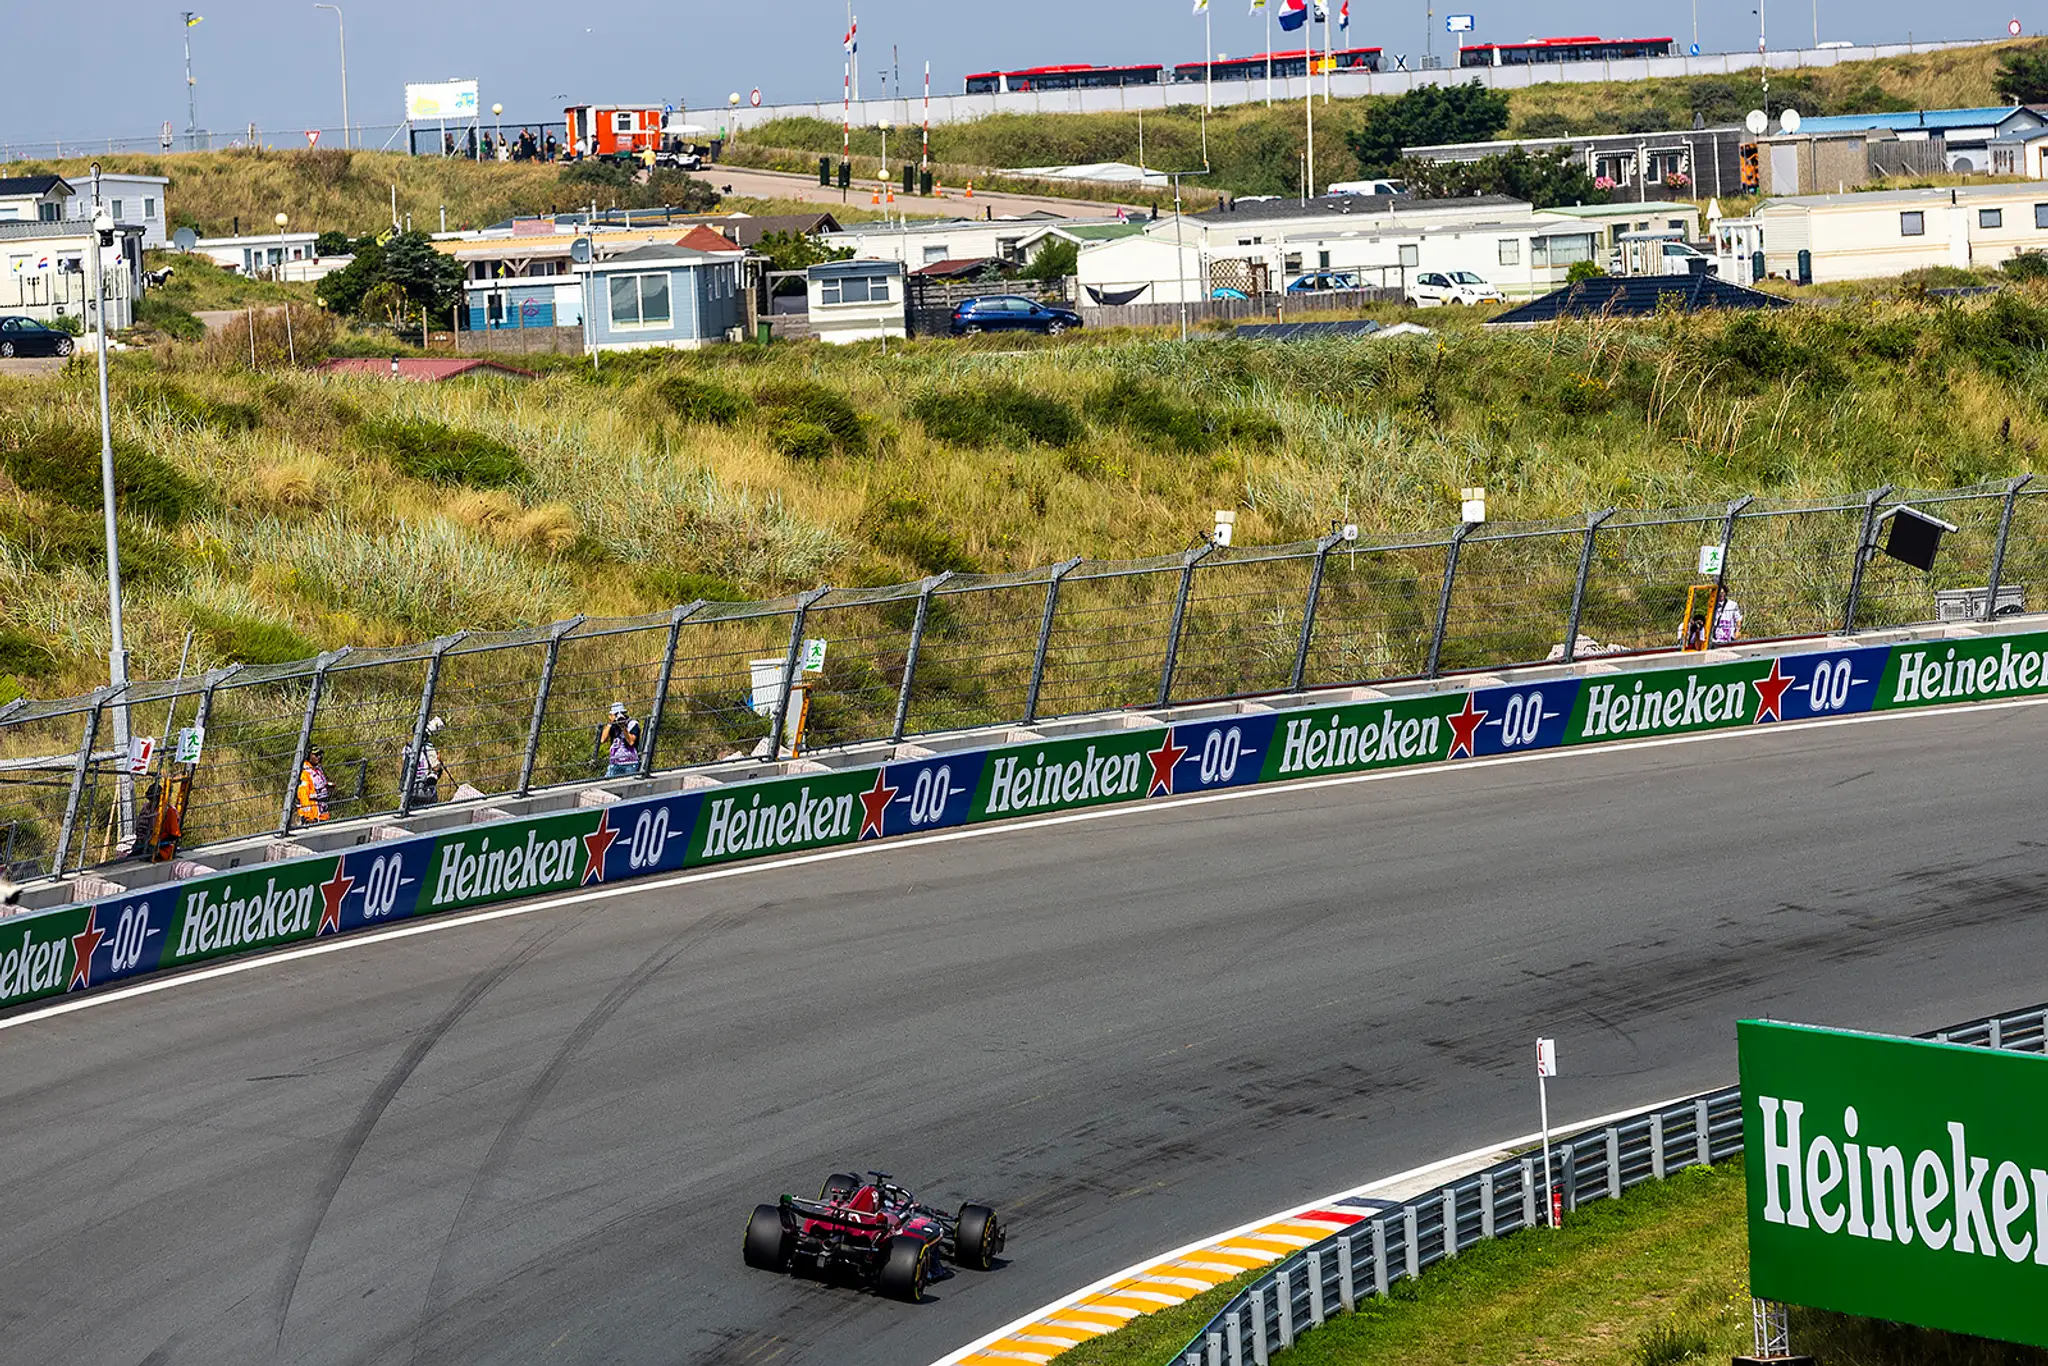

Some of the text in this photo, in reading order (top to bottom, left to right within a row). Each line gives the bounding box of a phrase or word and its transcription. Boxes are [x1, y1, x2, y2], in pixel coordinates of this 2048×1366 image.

[1279, 690, 1544, 773] Heineken 0.0
[1582, 656, 1852, 737] Heineken 0.0
[702, 765, 951, 858] Heineken 0.0
[986, 726, 1242, 814] Heineken 0.0
[432, 806, 670, 905] Heineken 0.0
[176, 850, 402, 957] Heineken 0.0
[0, 901, 150, 1000] eken 0.0
